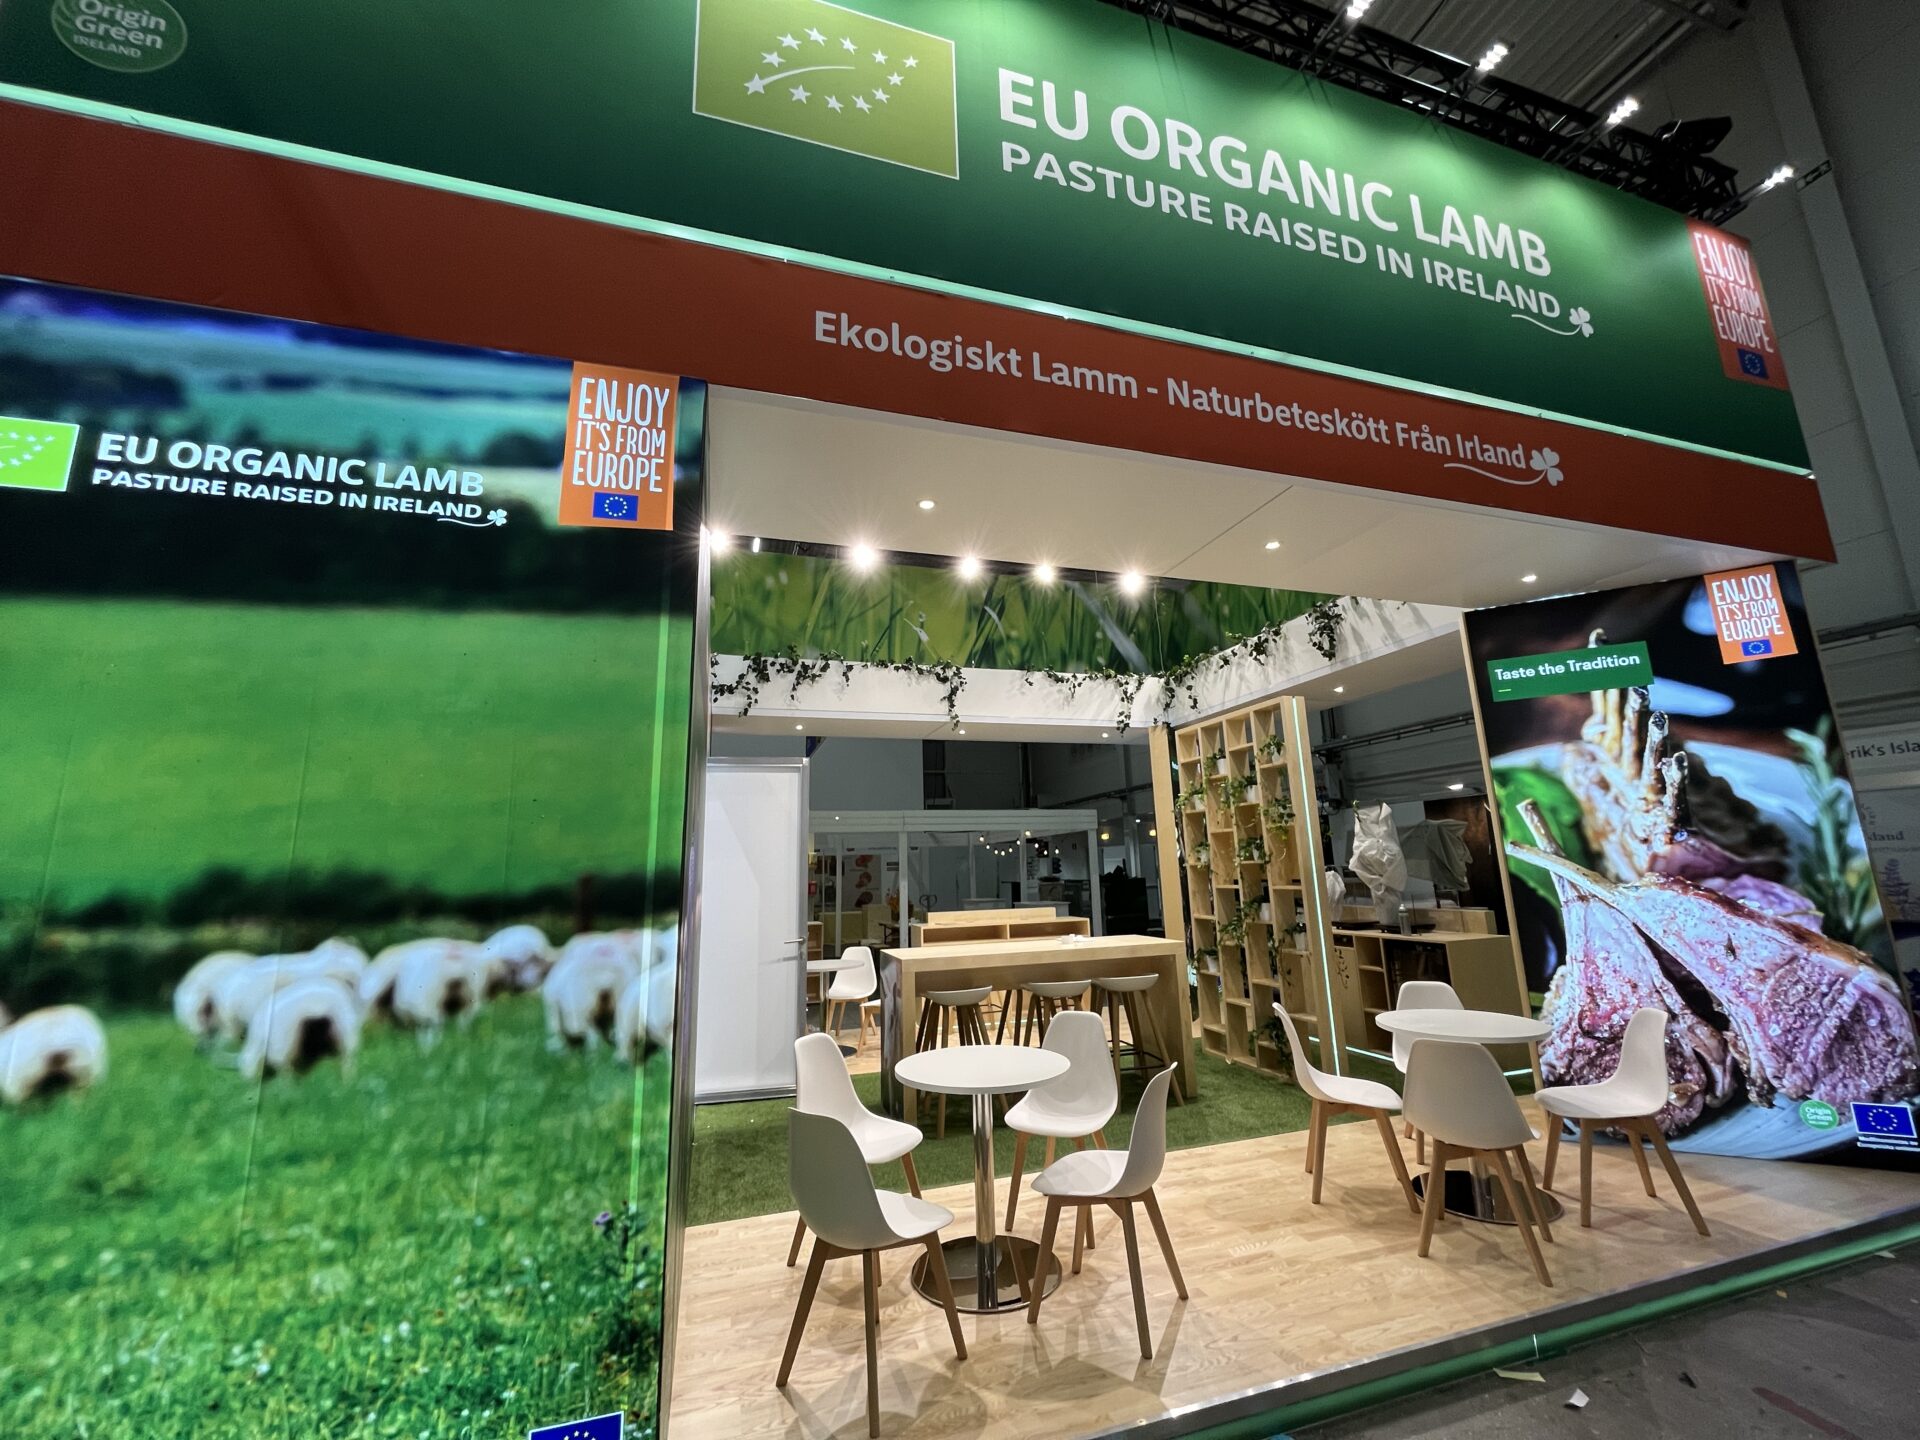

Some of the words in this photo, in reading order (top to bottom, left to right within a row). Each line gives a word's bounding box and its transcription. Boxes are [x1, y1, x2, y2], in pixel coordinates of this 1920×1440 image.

[74, 15, 164, 49] Green
[78, 0, 167, 32] Origin
[73, 34, 142, 58] IRELAND
[998, 67, 1089, 141] EU
[1111, 105, 1399, 232] ORGANIC
[1409, 193, 1552, 277] LAMB
[1001, 141, 1213, 225] PASTURE
[1224, 202, 1368, 265] RAISED
[1376, 245, 1415, 280] IN
[1422, 257, 1561, 319] IRELAND
[1693, 231, 1755, 289] ENJOY
[1705, 275, 1732, 308] IT'S
[1729, 282, 1764, 318] FROM
[1712, 304, 1774, 353] EUROPE
[578, 377, 670, 428] ENJOY
[814, 310, 1023, 373] Ekologiskt
[1032, 351, 1139, 399] Lamm
[1146, 385, 1158, 395] -
[1167, 377, 1391, 446] Naturbeteskött
[1395, 421, 1453, 457] Från
[1456, 433, 1527, 469] Irland
[575, 420, 611, 451] IT'S
[615, 425, 666, 457] FROM
[96, 432, 159, 465] EU
[167, 440, 366, 487] ORGANIC
[374, 462, 485, 497] LAMB
[572, 450, 665, 492] EUROPE
[92, 468, 227, 496] PASTURE
[232, 481, 334, 506] RAISED
[339, 491, 368, 509] IN
[373, 494, 483, 519] IRELAND
[1711, 573, 1773, 606] ENJOY
[1717, 603, 1743, 622] IT'S
[1742, 598, 1779, 619] FROM
[1721, 614, 1784, 642] EUROPE
[1494, 667, 1536, 681] Taste
[1538, 663, 1565, 675] the
[1566, 654, 1641, 672] Tradition
[1847, 744, 1886, 759] rik's
